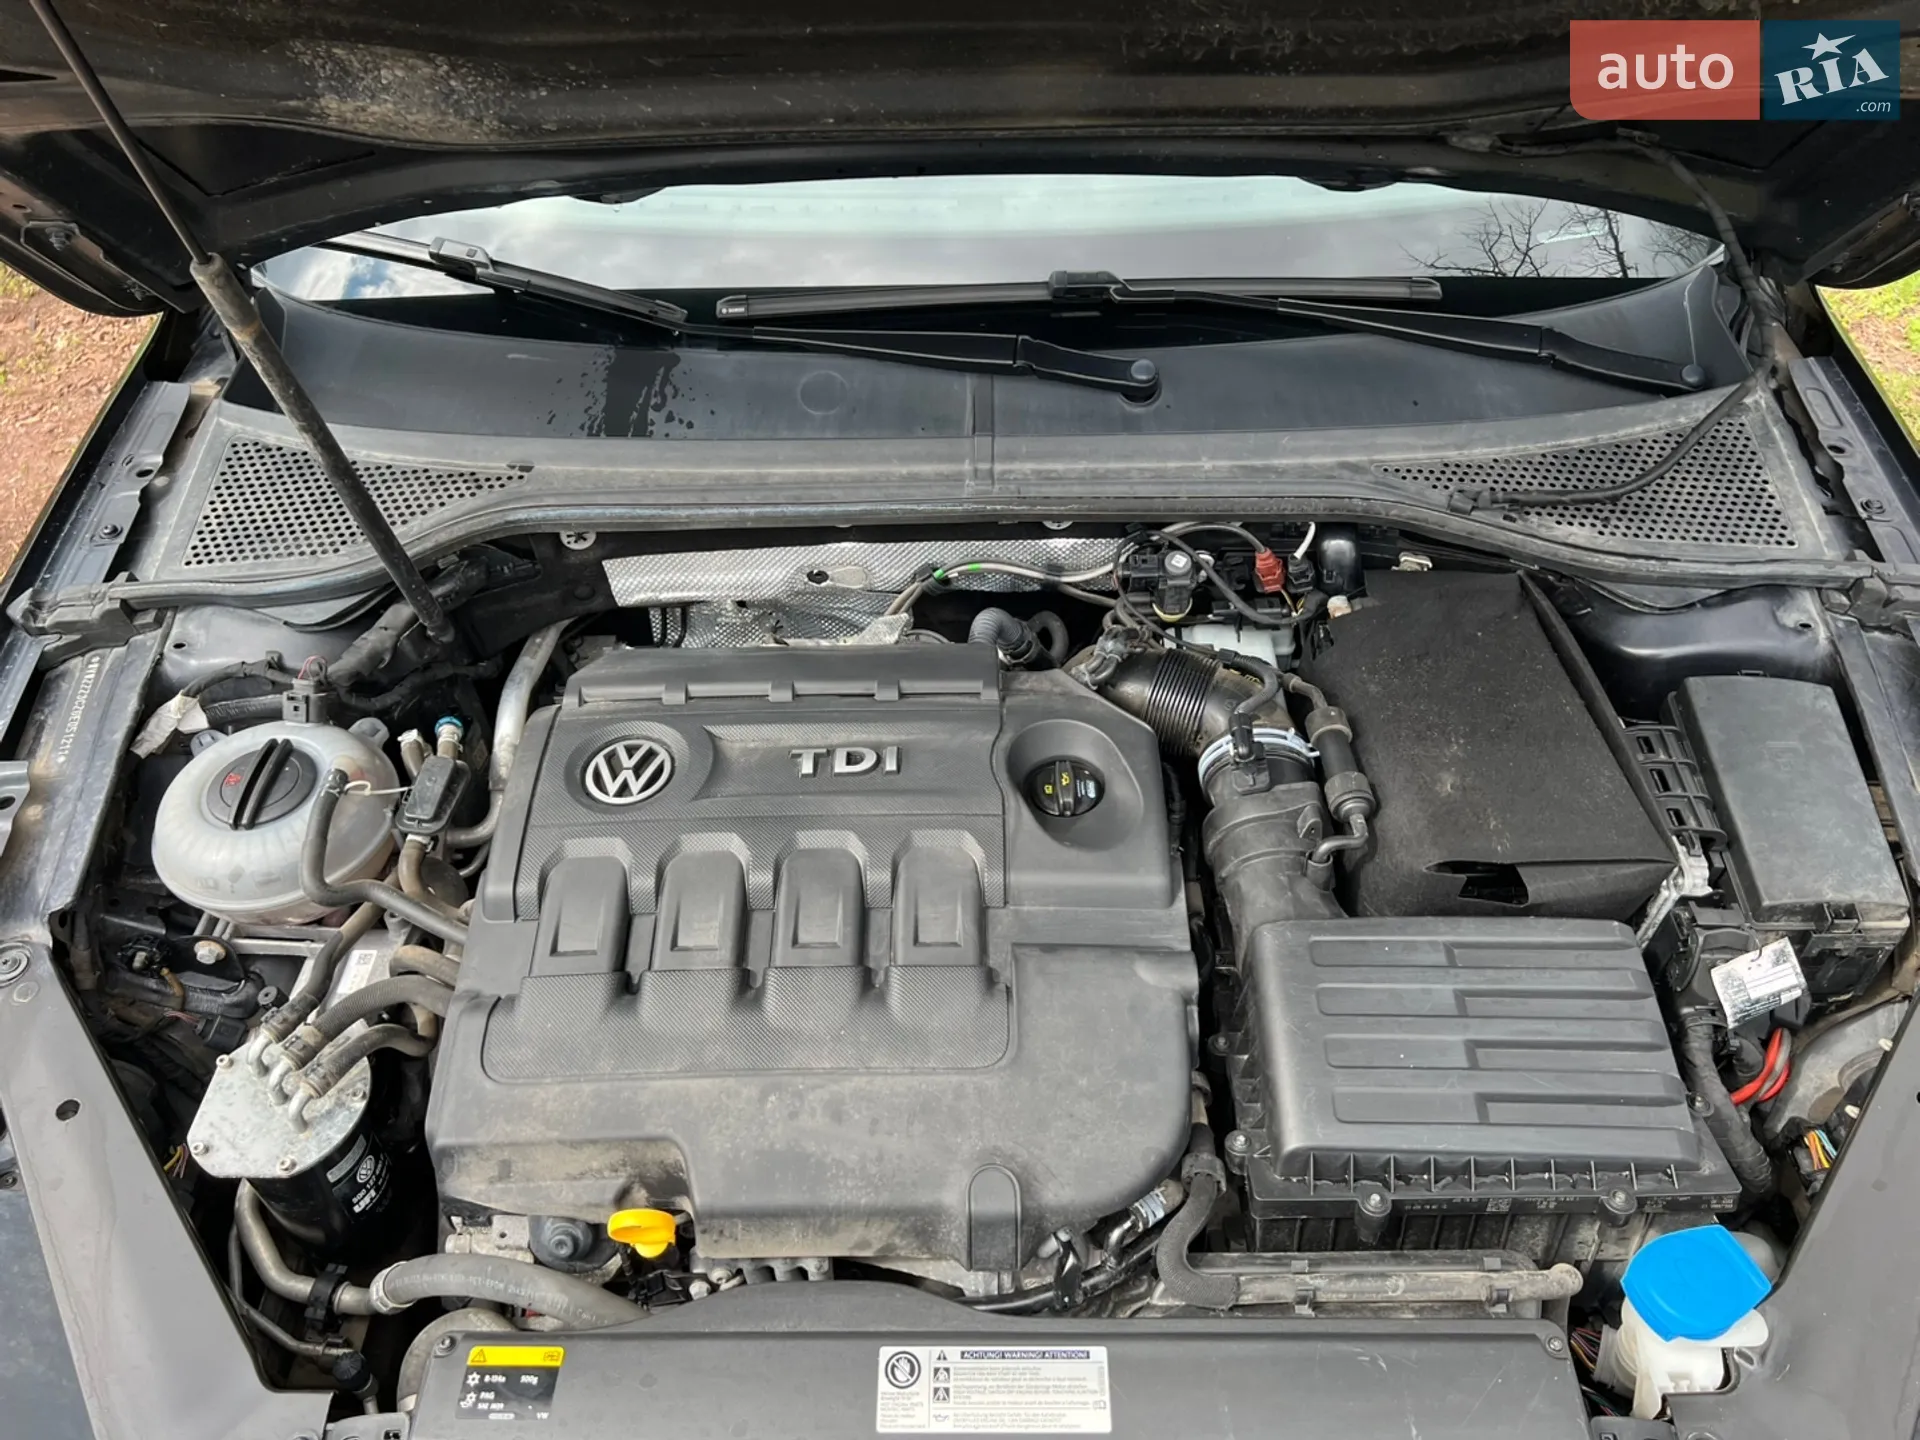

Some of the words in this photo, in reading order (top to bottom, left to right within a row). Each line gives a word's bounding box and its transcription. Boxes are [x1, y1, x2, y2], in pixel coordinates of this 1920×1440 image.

[789, 746, 901, 779] TDI
[962, 1350, 1000, 1360] ACHTUNG!
[1044, 1350, 1088, 1360] ATTENTION!
